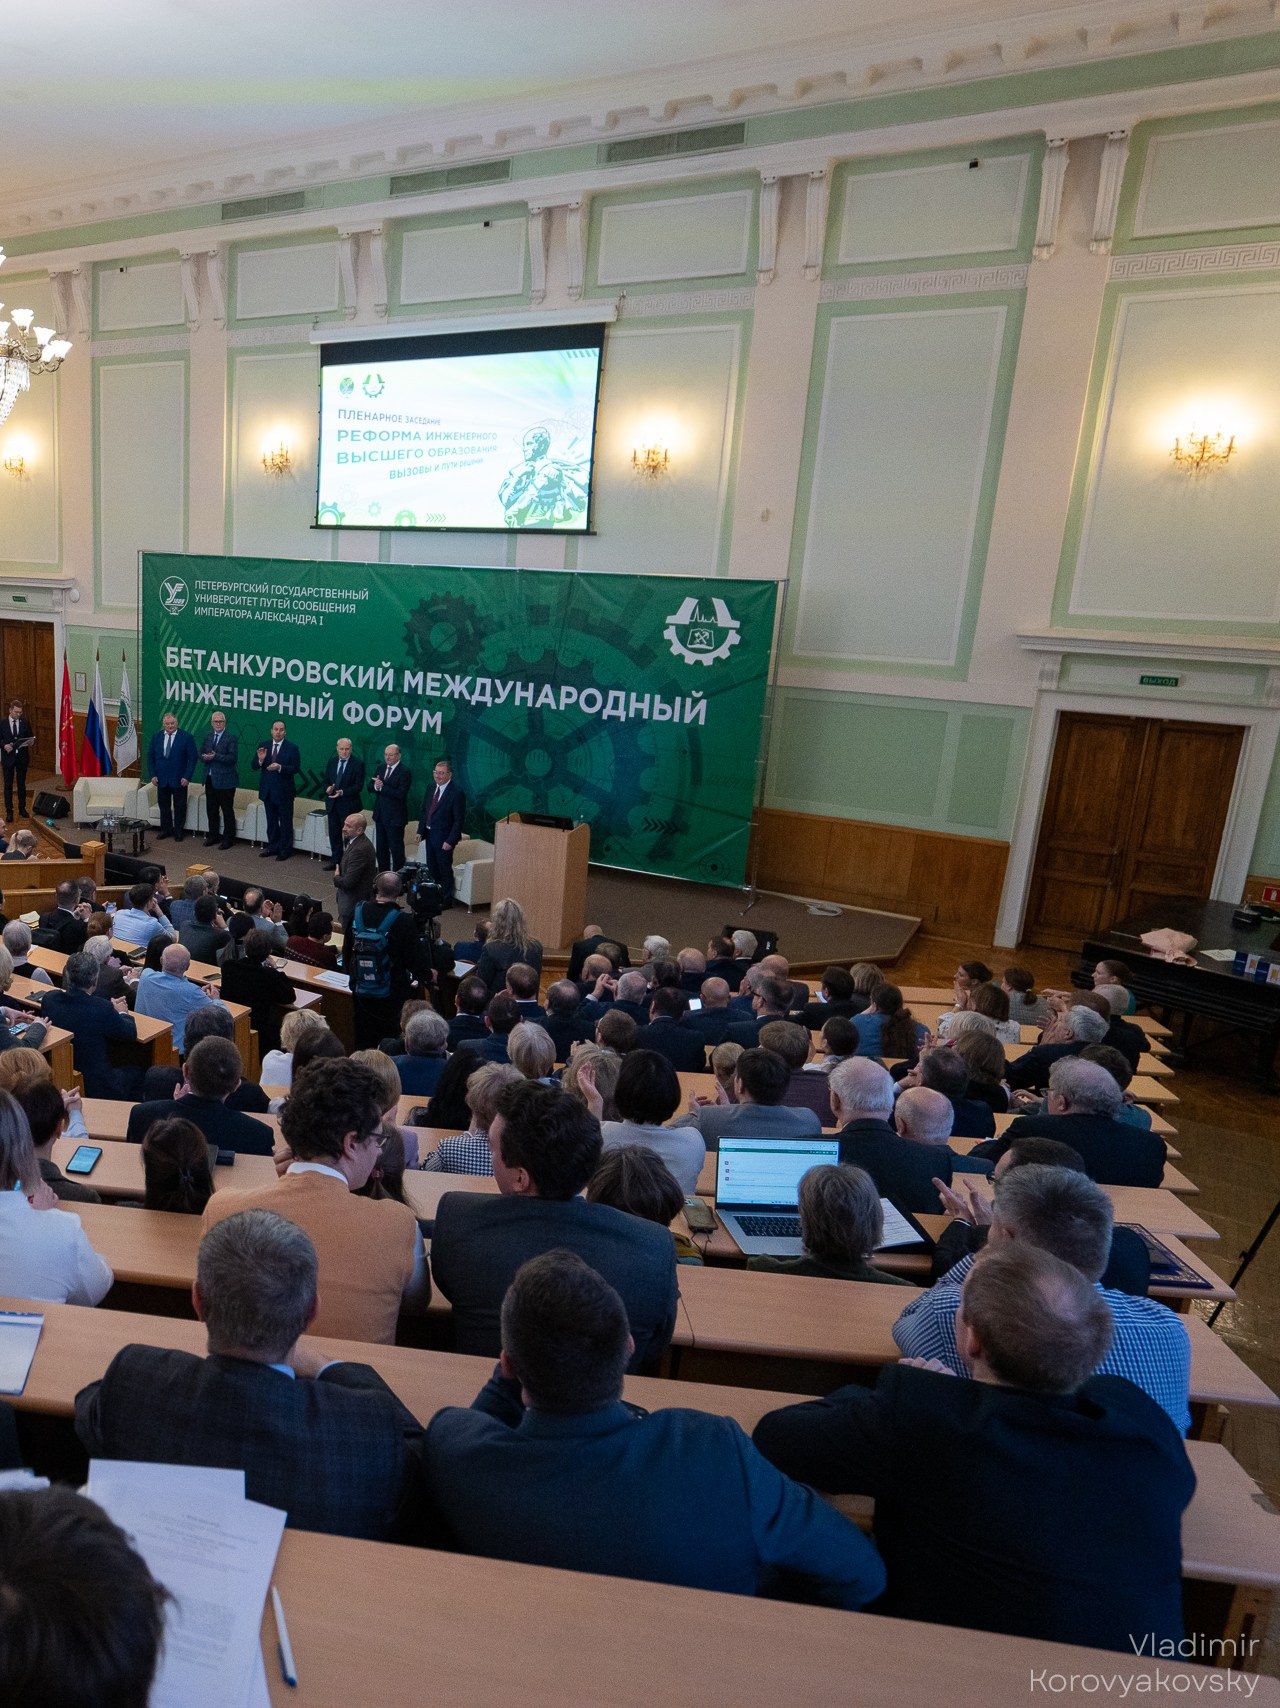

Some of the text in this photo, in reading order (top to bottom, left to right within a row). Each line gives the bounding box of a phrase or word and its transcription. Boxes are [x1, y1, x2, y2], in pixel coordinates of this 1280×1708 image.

[338, 409, 441, 426] ПЛЕНАРНОЕ ЗАСЕДАНИЕ
[337, 430, 498, 442] РЕФОРМА ИНЖЕНЕРНОГО
[337, 445, 498, 465] ВЫСШЕГО ОБРАЗОВАНИЯ
[194, 580, 369, 601] ПЕТЕРБУРГСКИЙ ГОСУДАРСТВЕННЫЙ
[194, 594, 258, 607] УНИВЕРСИТЕТ
[260, 597, 291, 609] ПУТЕЙ
[293, 600, 356, 614] СООБЩЕНИЯ
[194, 607, 253, 620] ИМПЕРАТОРА
[254, 611, 317, 626] АЛЕКСАНДРА
[165, 646, 708, 726] БЕТАНКУРОВСКИЙ МЕЖДУНАРОДНЫЙ
[165, 679, 335, 722] ИНЖЕНЕРНЫЙ
[342, 700, 443, 735] ФОРУМ
